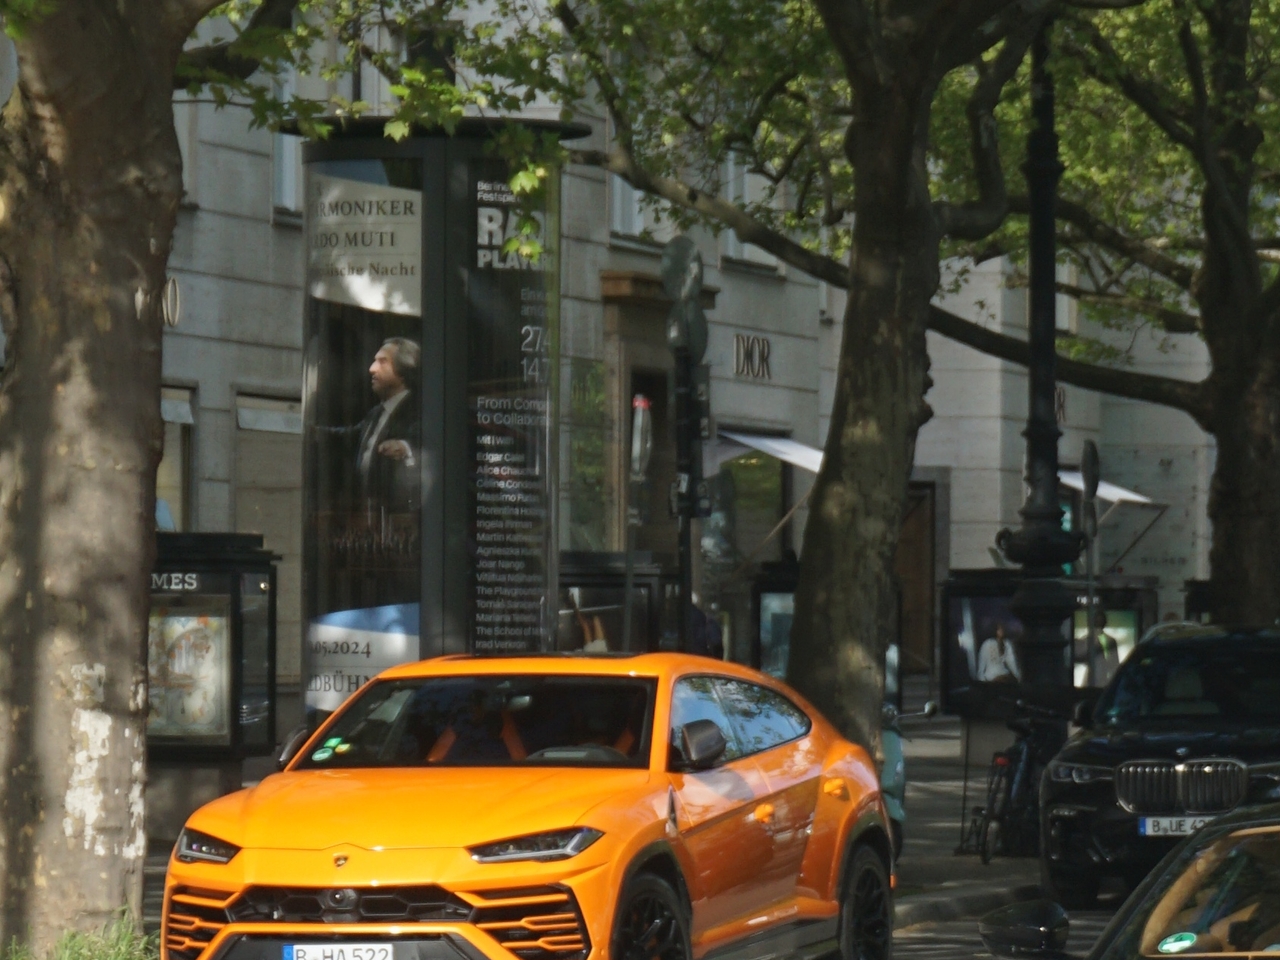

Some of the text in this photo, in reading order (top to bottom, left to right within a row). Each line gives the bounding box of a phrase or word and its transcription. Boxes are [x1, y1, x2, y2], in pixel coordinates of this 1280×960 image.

[344, 232, 395, 248] MUTI
[369, 261, 416, 276] Nacht
[734, 334, 771, 379] DIOR
[478, 397, 510, 409] From
[477, 411, 489, 423] to
[151, 573, 197, 589] MES
[1152, 820, 1160, 832] B
[1169, 820, 1186, 832] UE
